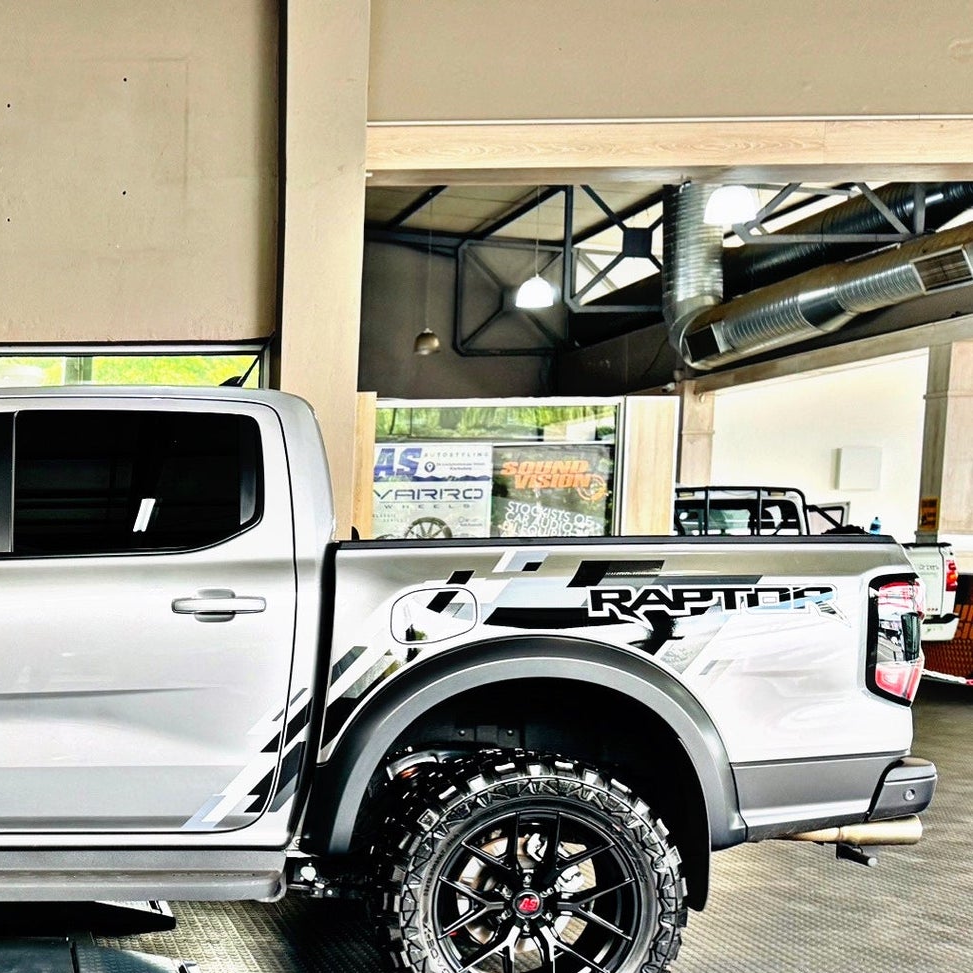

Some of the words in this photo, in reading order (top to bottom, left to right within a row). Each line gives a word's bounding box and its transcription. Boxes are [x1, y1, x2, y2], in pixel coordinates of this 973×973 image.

[373, 448, 423, 476] AS
[500, 461, 589, 475] SOUND
[514, 473, 591, 489] VISION
[506, 501, 571, 522] STOCKISTS
[588, 585, 851, 628] RAPTOR
